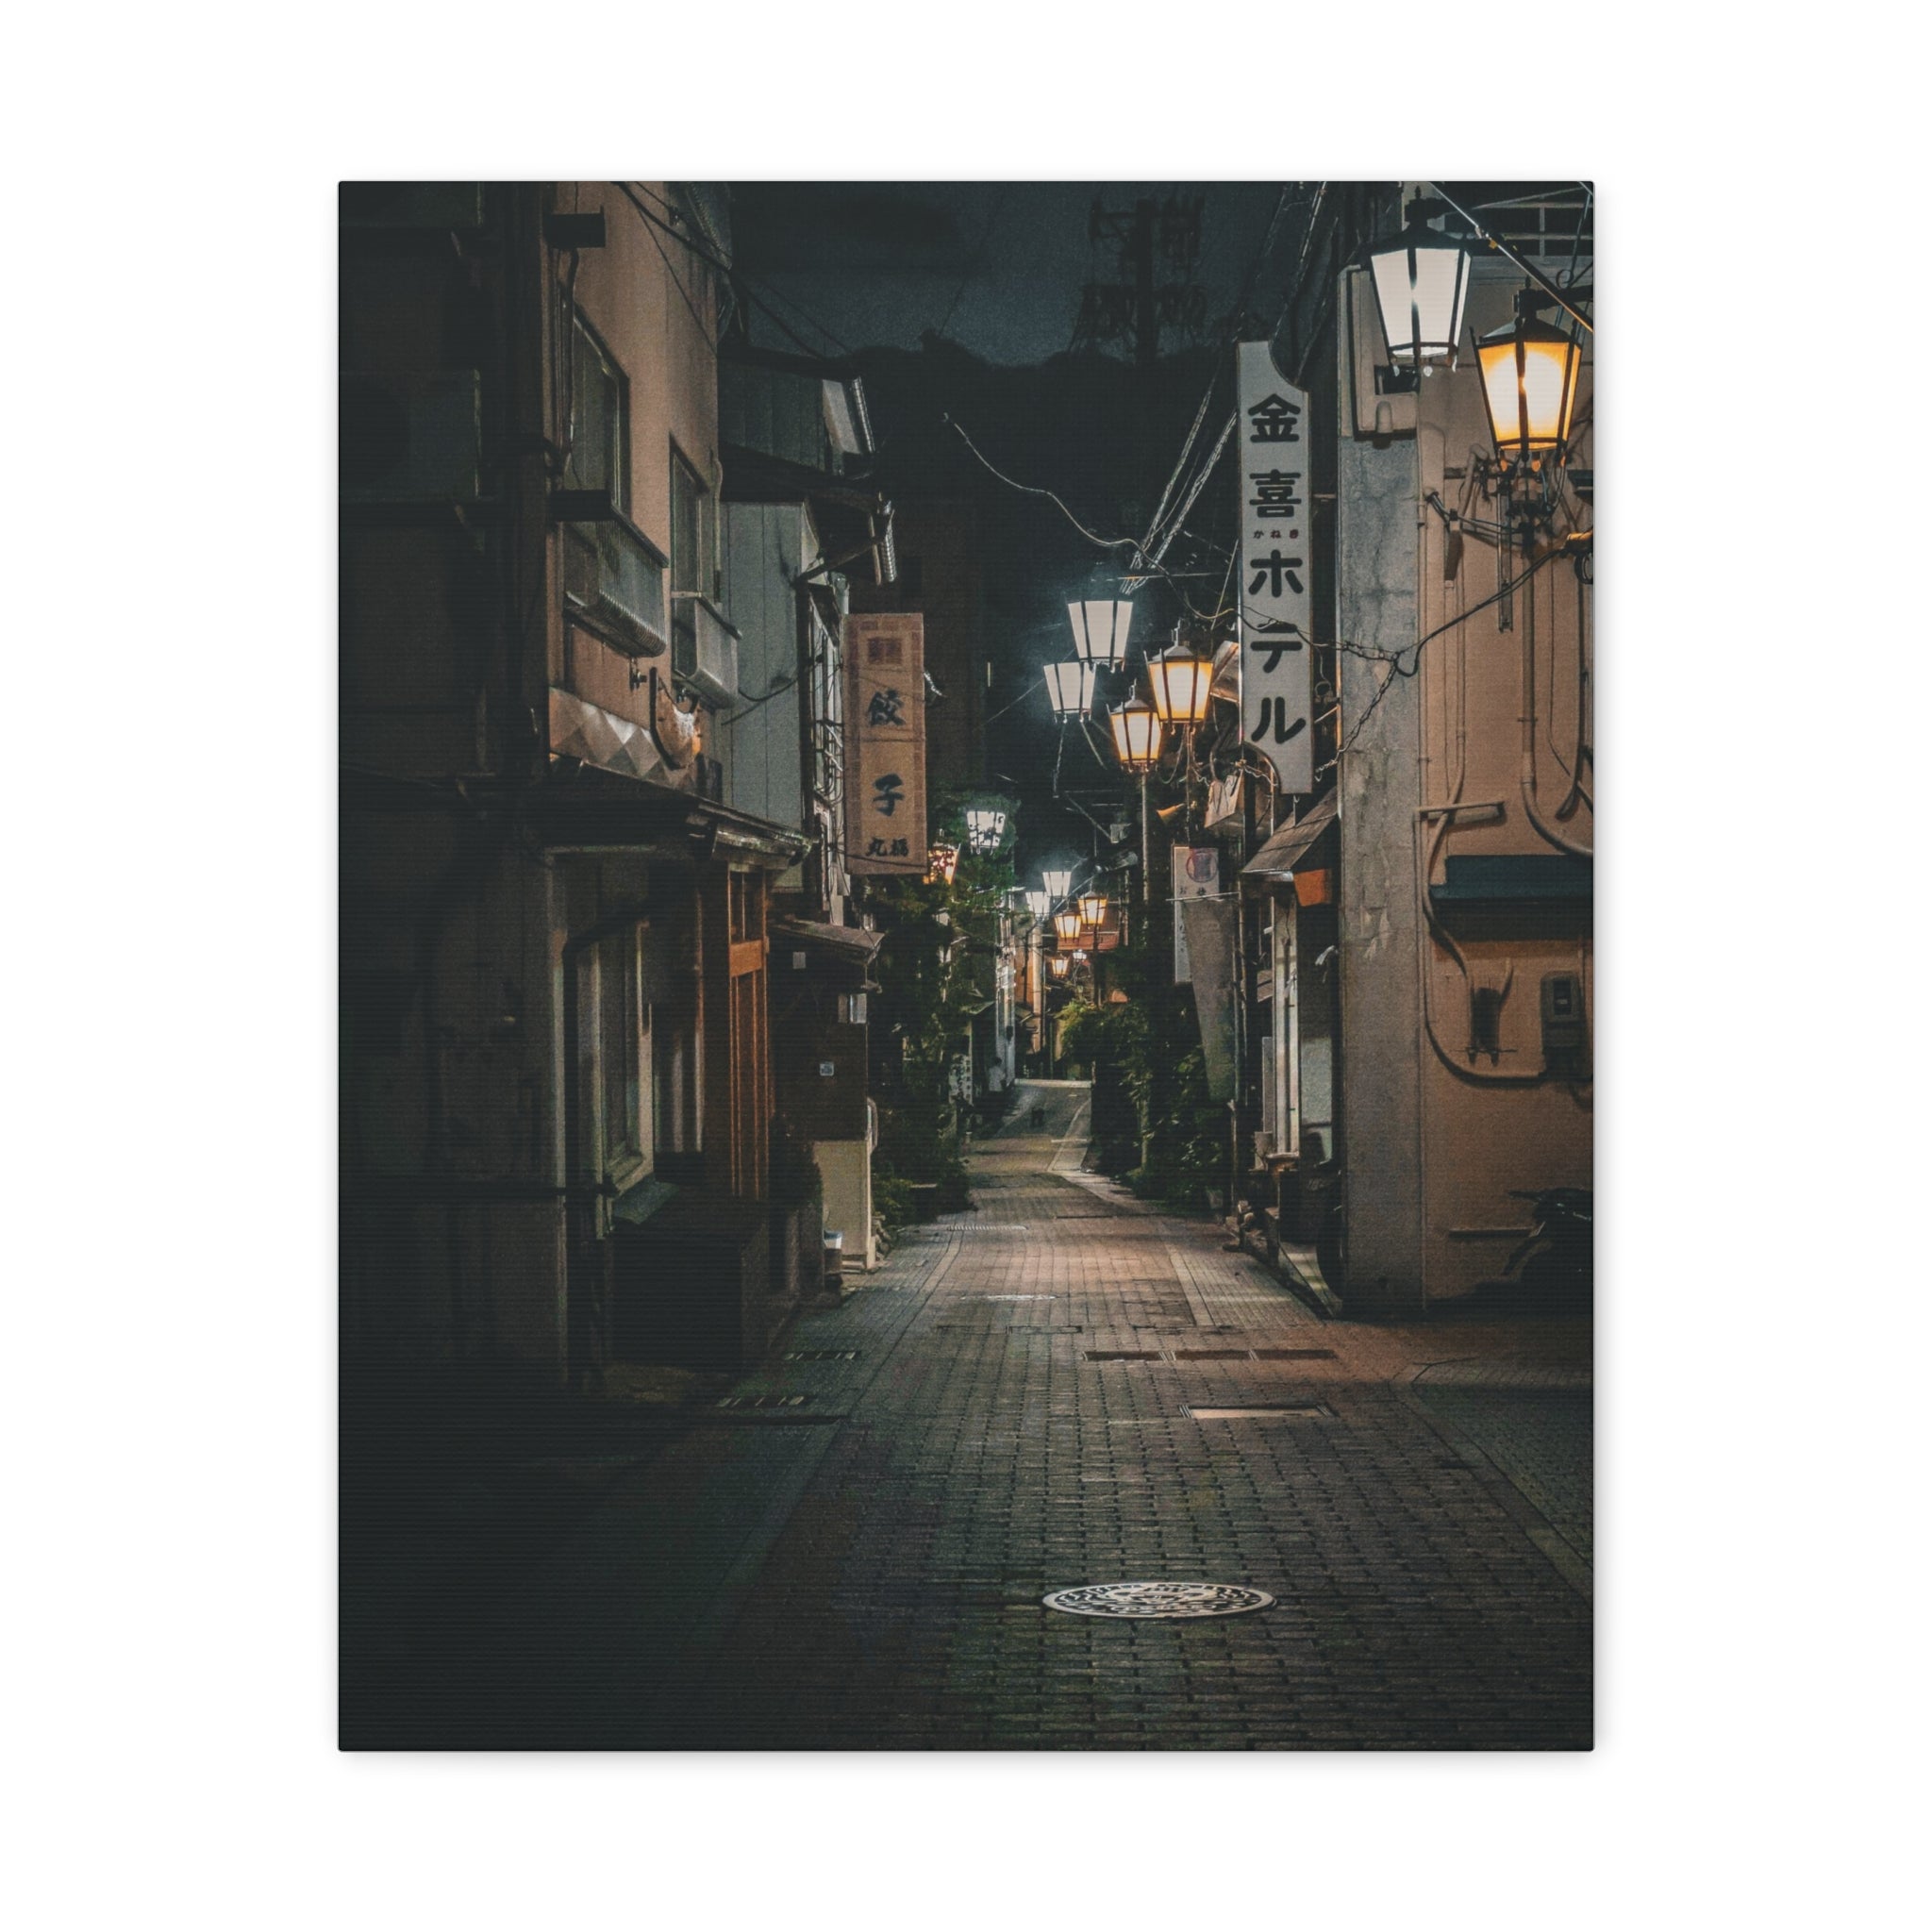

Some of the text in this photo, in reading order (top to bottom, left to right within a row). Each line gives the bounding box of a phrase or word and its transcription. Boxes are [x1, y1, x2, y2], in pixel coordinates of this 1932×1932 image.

[1248, 393, 1306, 744] 金喜ホテル
[868, 690, 906, 817] 餃子
